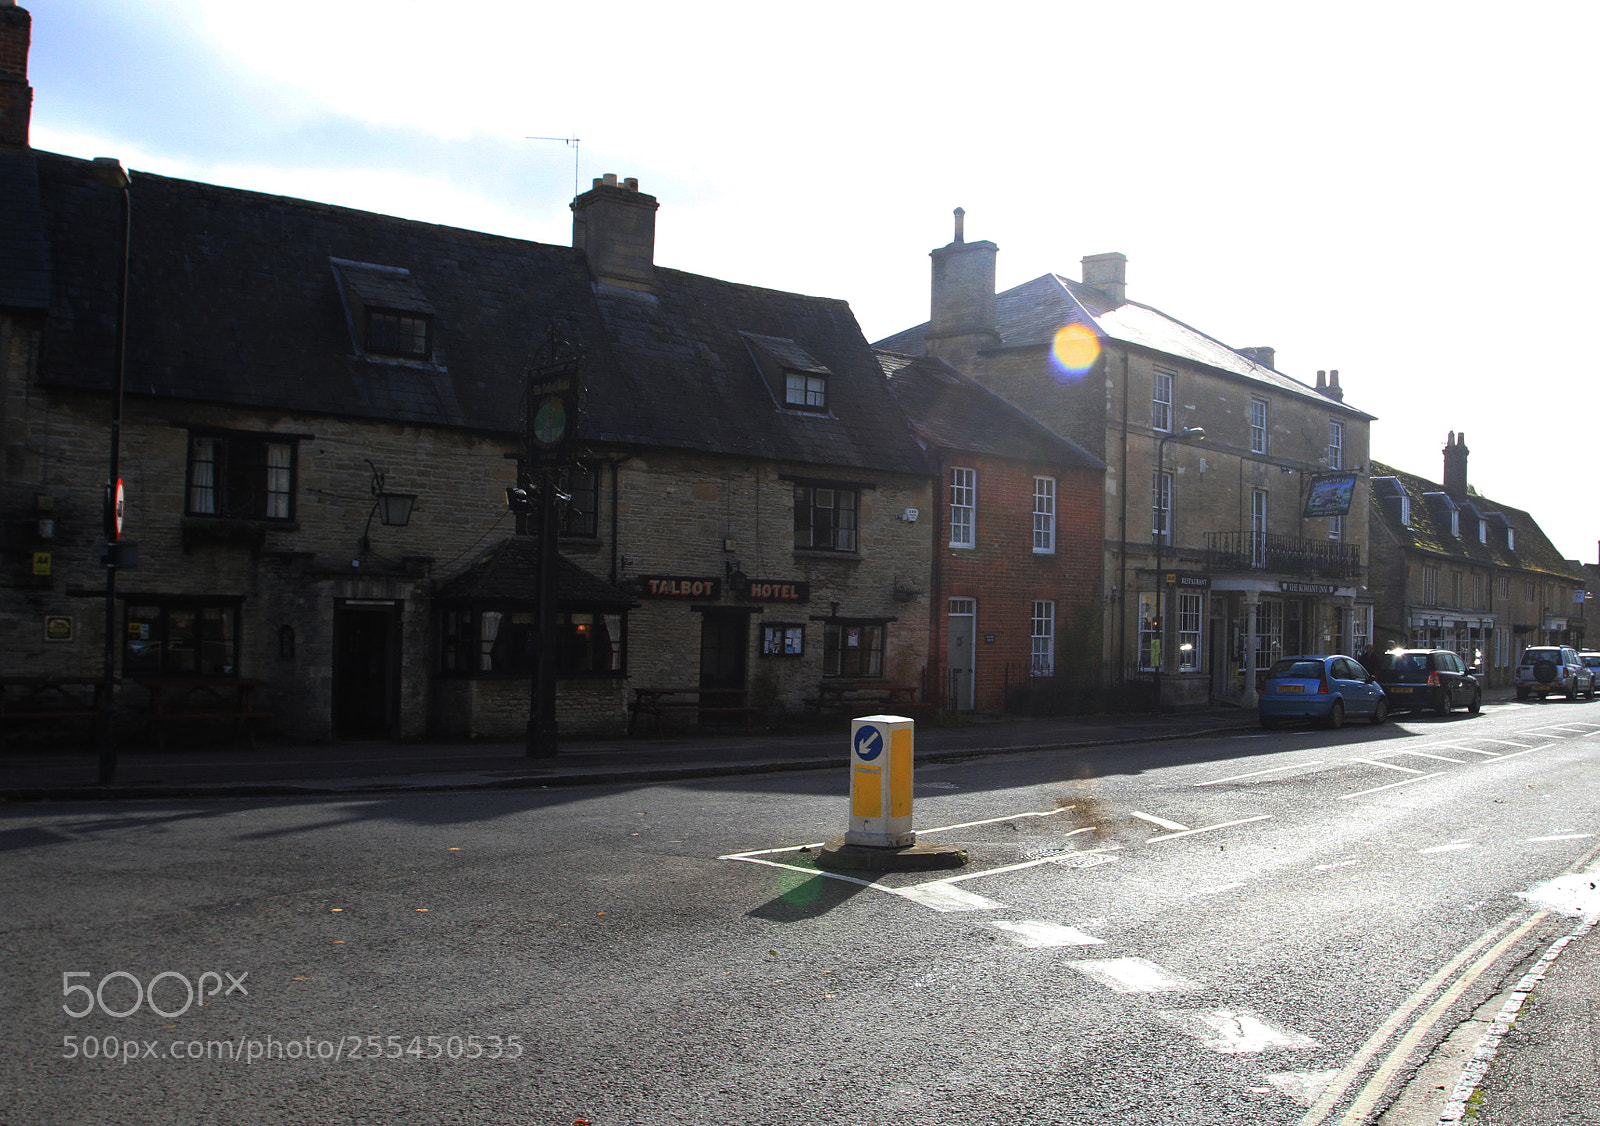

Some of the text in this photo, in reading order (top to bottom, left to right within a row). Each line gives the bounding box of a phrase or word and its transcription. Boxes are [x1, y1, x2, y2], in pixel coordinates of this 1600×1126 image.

[1181, 577, 1207, 587] RESTAURANT
[648, 579, 799, 600] TALBOT HOTEL
[1289, 583, 1328, 594] THE ROMANY INN
